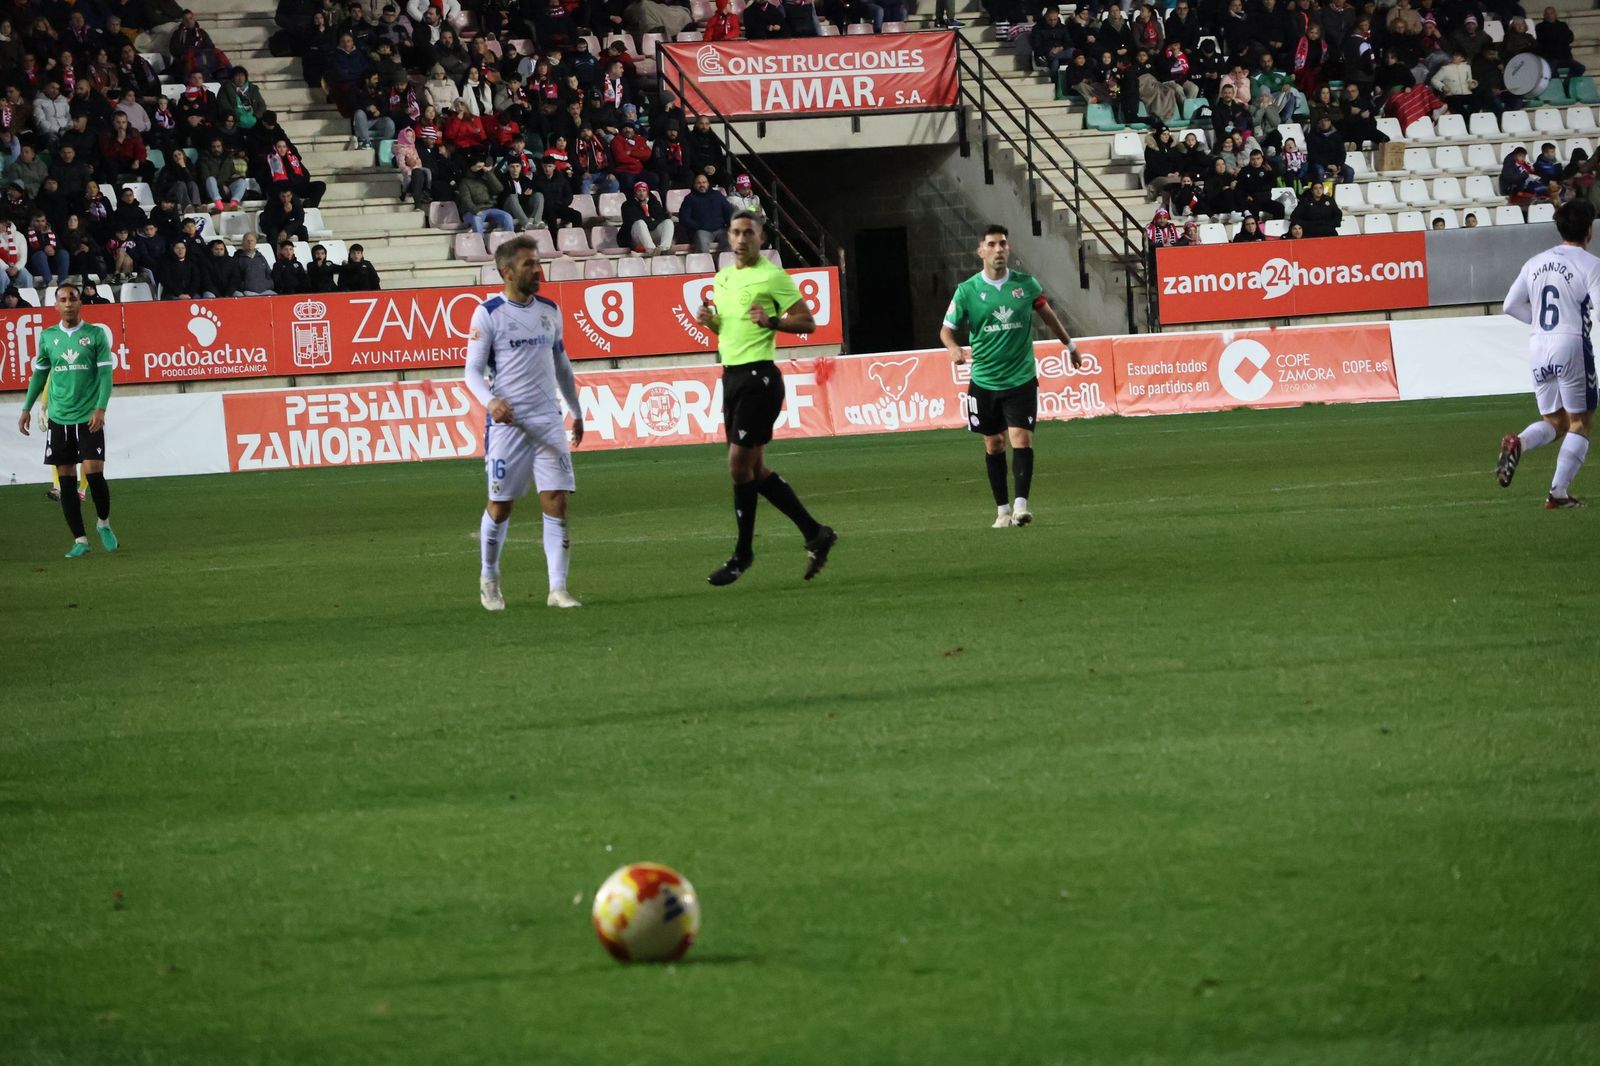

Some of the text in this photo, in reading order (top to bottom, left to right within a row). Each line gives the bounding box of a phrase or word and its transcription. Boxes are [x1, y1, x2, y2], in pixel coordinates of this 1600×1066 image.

[750, 75, 926, 112] TAMAR, S.A.
[1163, 258, 1424, 296] zamora24horas.com
[349, 292, 502, 343] ZAMO
[602, 290, 624, 327] 8
[1539, 284, 1560, 331] 6
[573, 310, 612, 353] ZAMORA
[672, 304, 709, 348] ZAMORA
[144, 343, 267, 378] podoactiva
[162, 366, 206, 377] PODOLOGÍA
[214, 363, 267, 375] BIOMECÁNICA
[351, 347, 467, 366] AYUNTAMIENTO
[1127, 359, 1208, 377] Escucha todos
[1276, 353, 1311, 367] COPE
[1342, 359, 1388, 375] COPE.es
[1128, 380, 1210, 398] los partidos en
[1278, 368, 1336, 383] ZAMORA
[556, 378, 724, 440] AMOR
[237, 421, 477, 470] ZAMORANAS
[491, 458, 506, 479] 16
